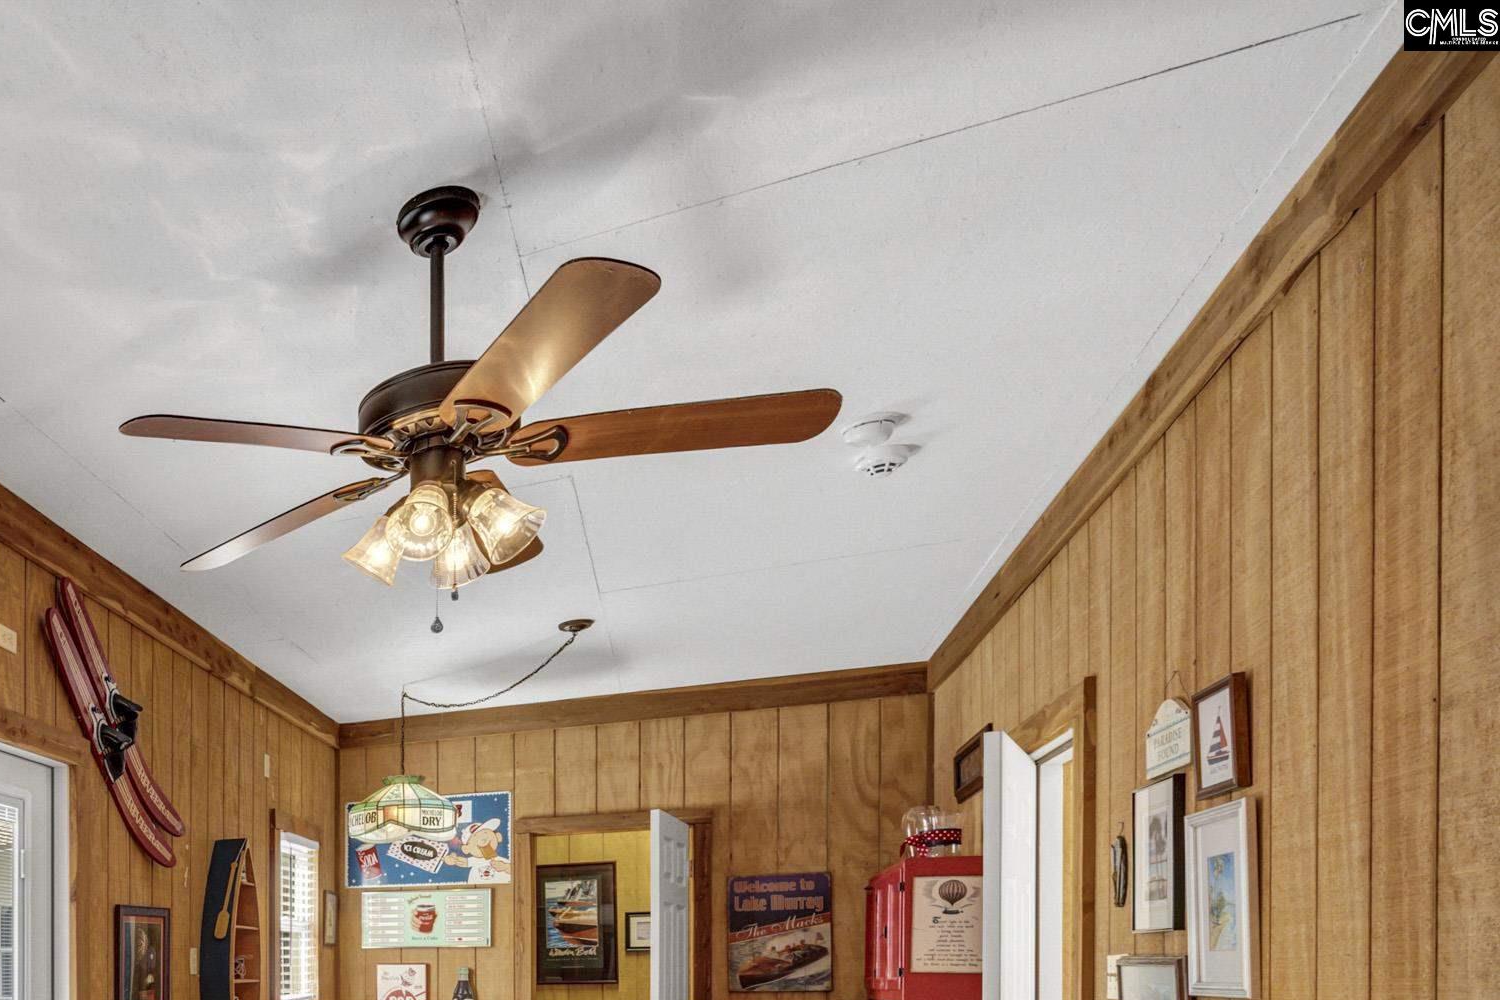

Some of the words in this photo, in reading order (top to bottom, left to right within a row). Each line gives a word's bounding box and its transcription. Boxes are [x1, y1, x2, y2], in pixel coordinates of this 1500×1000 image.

[422, 816, 442, 826] DRY
[413, 846, 434, 857] CREAM
[359, 852, 379, 868] SODA
[733, 880, 796, 893] Welcome
[800, 878, 815, 890] to
[734, 896, 767, 912] Lake
[770, 895, 824, 911] Murray
